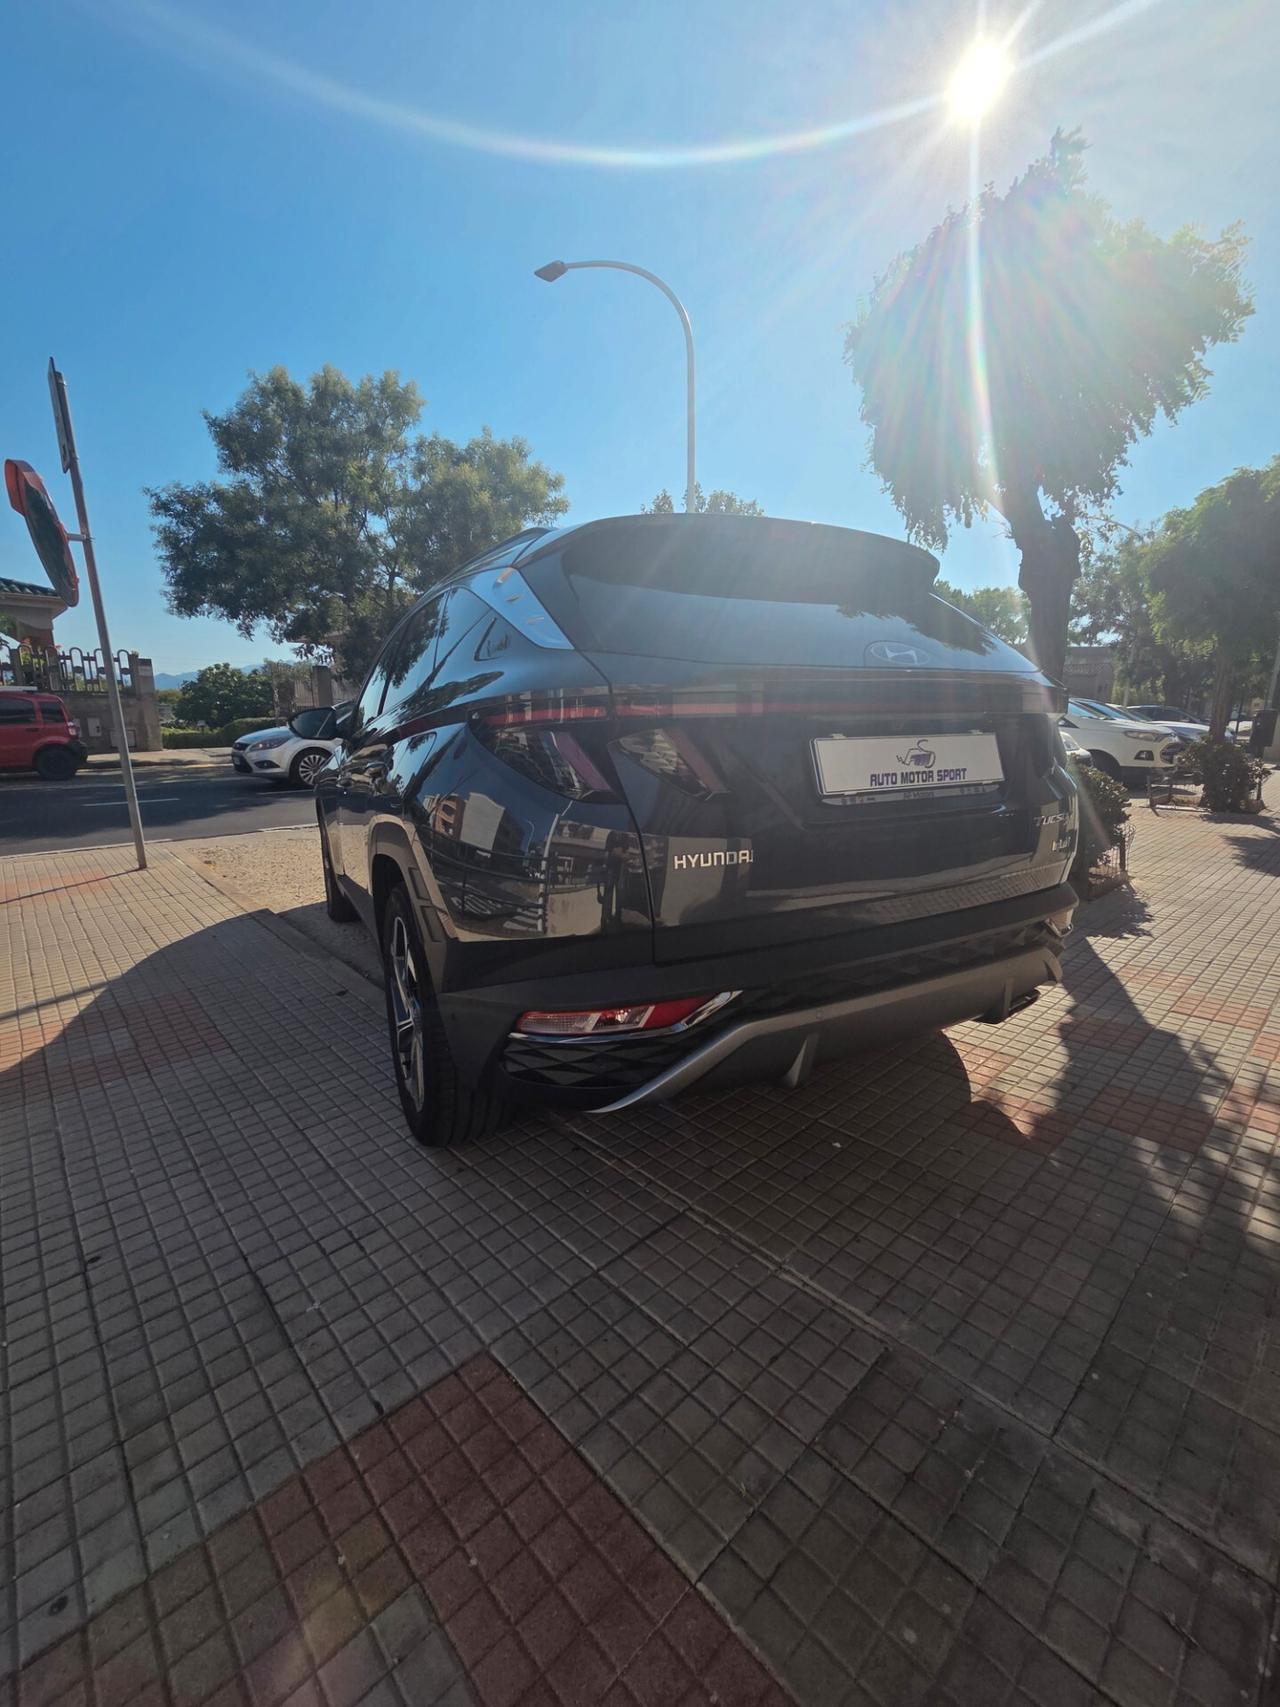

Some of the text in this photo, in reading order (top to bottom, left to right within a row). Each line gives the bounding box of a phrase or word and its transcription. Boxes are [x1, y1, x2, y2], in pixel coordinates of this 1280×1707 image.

[870, 768, 967, 787] AUTO MOTOR SPORT
[1033, 812, 1073, 827] TUCS
[674, 849, 754, 869] HYUNDAI
